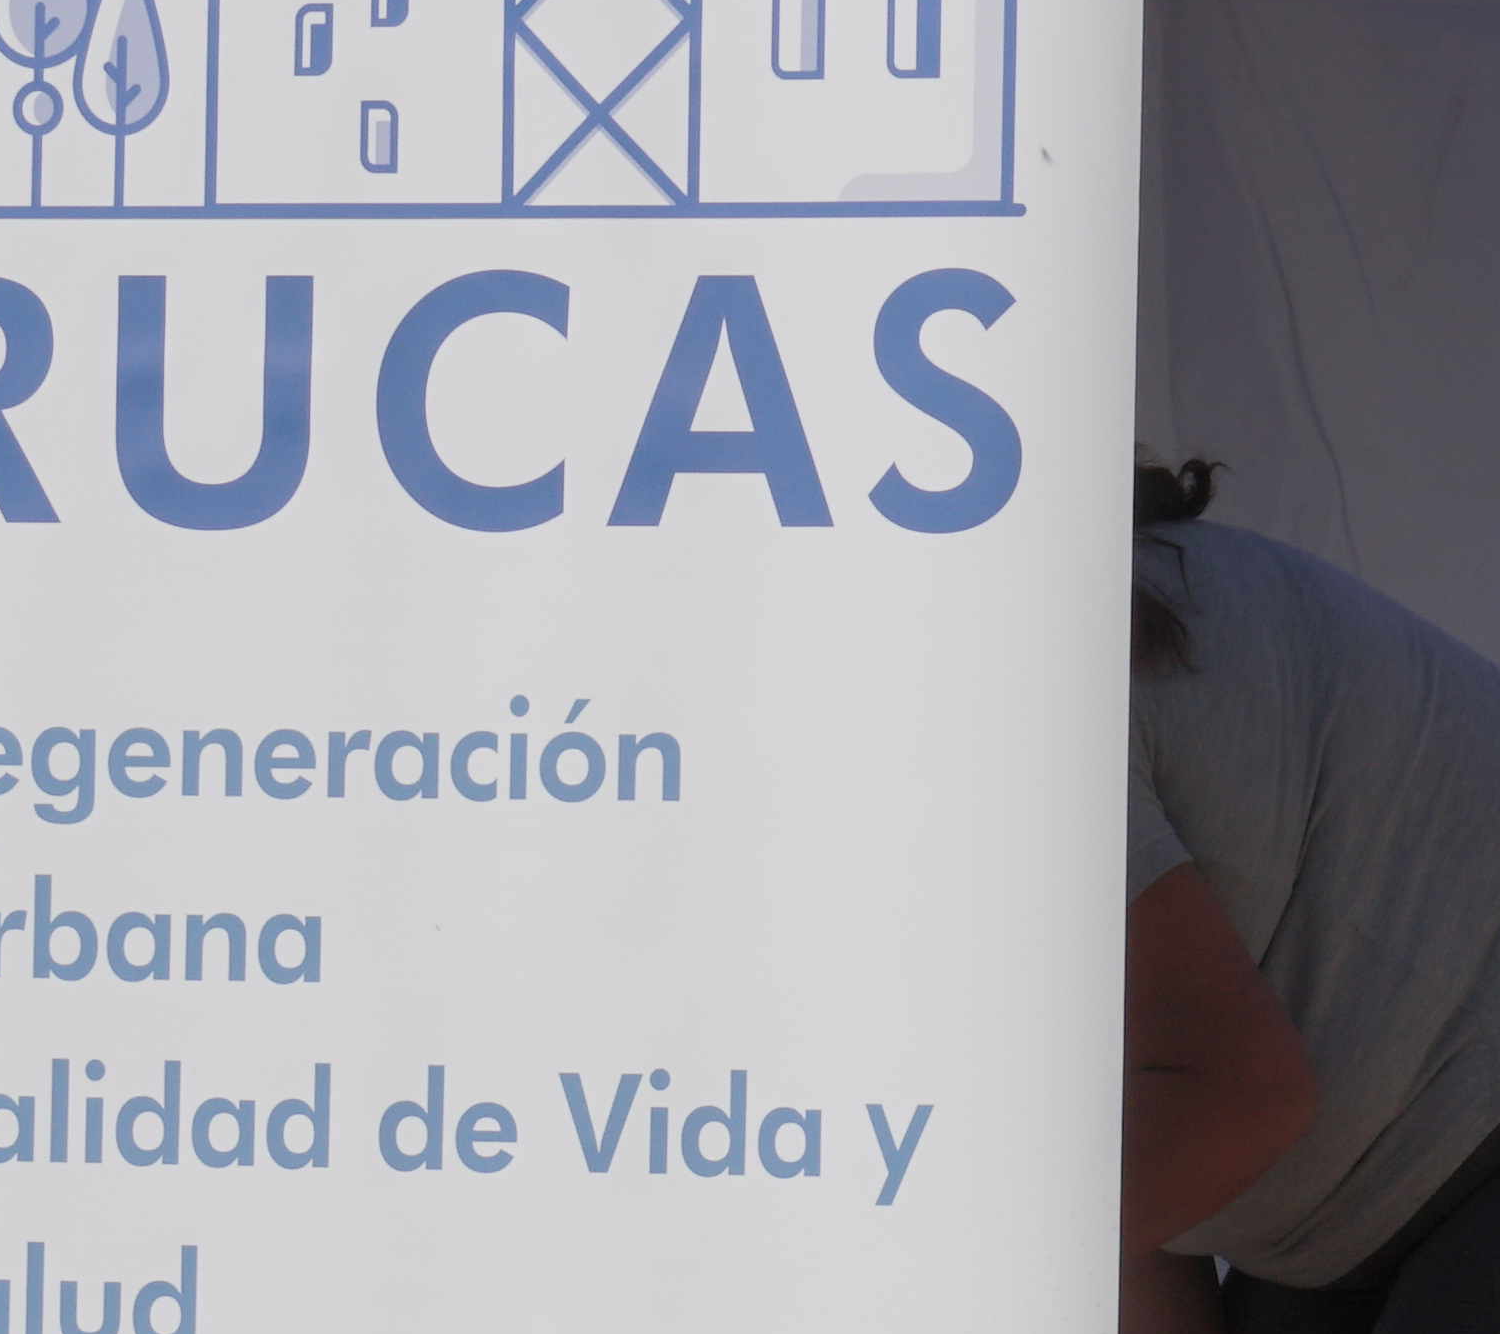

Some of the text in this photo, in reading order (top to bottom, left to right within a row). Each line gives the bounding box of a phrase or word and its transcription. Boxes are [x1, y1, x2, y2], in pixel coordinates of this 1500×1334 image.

[379, 1065, 517, 1173] de
[559, 1069, 821, 1179] Vida
[866, 1104, 934, 1206] y
